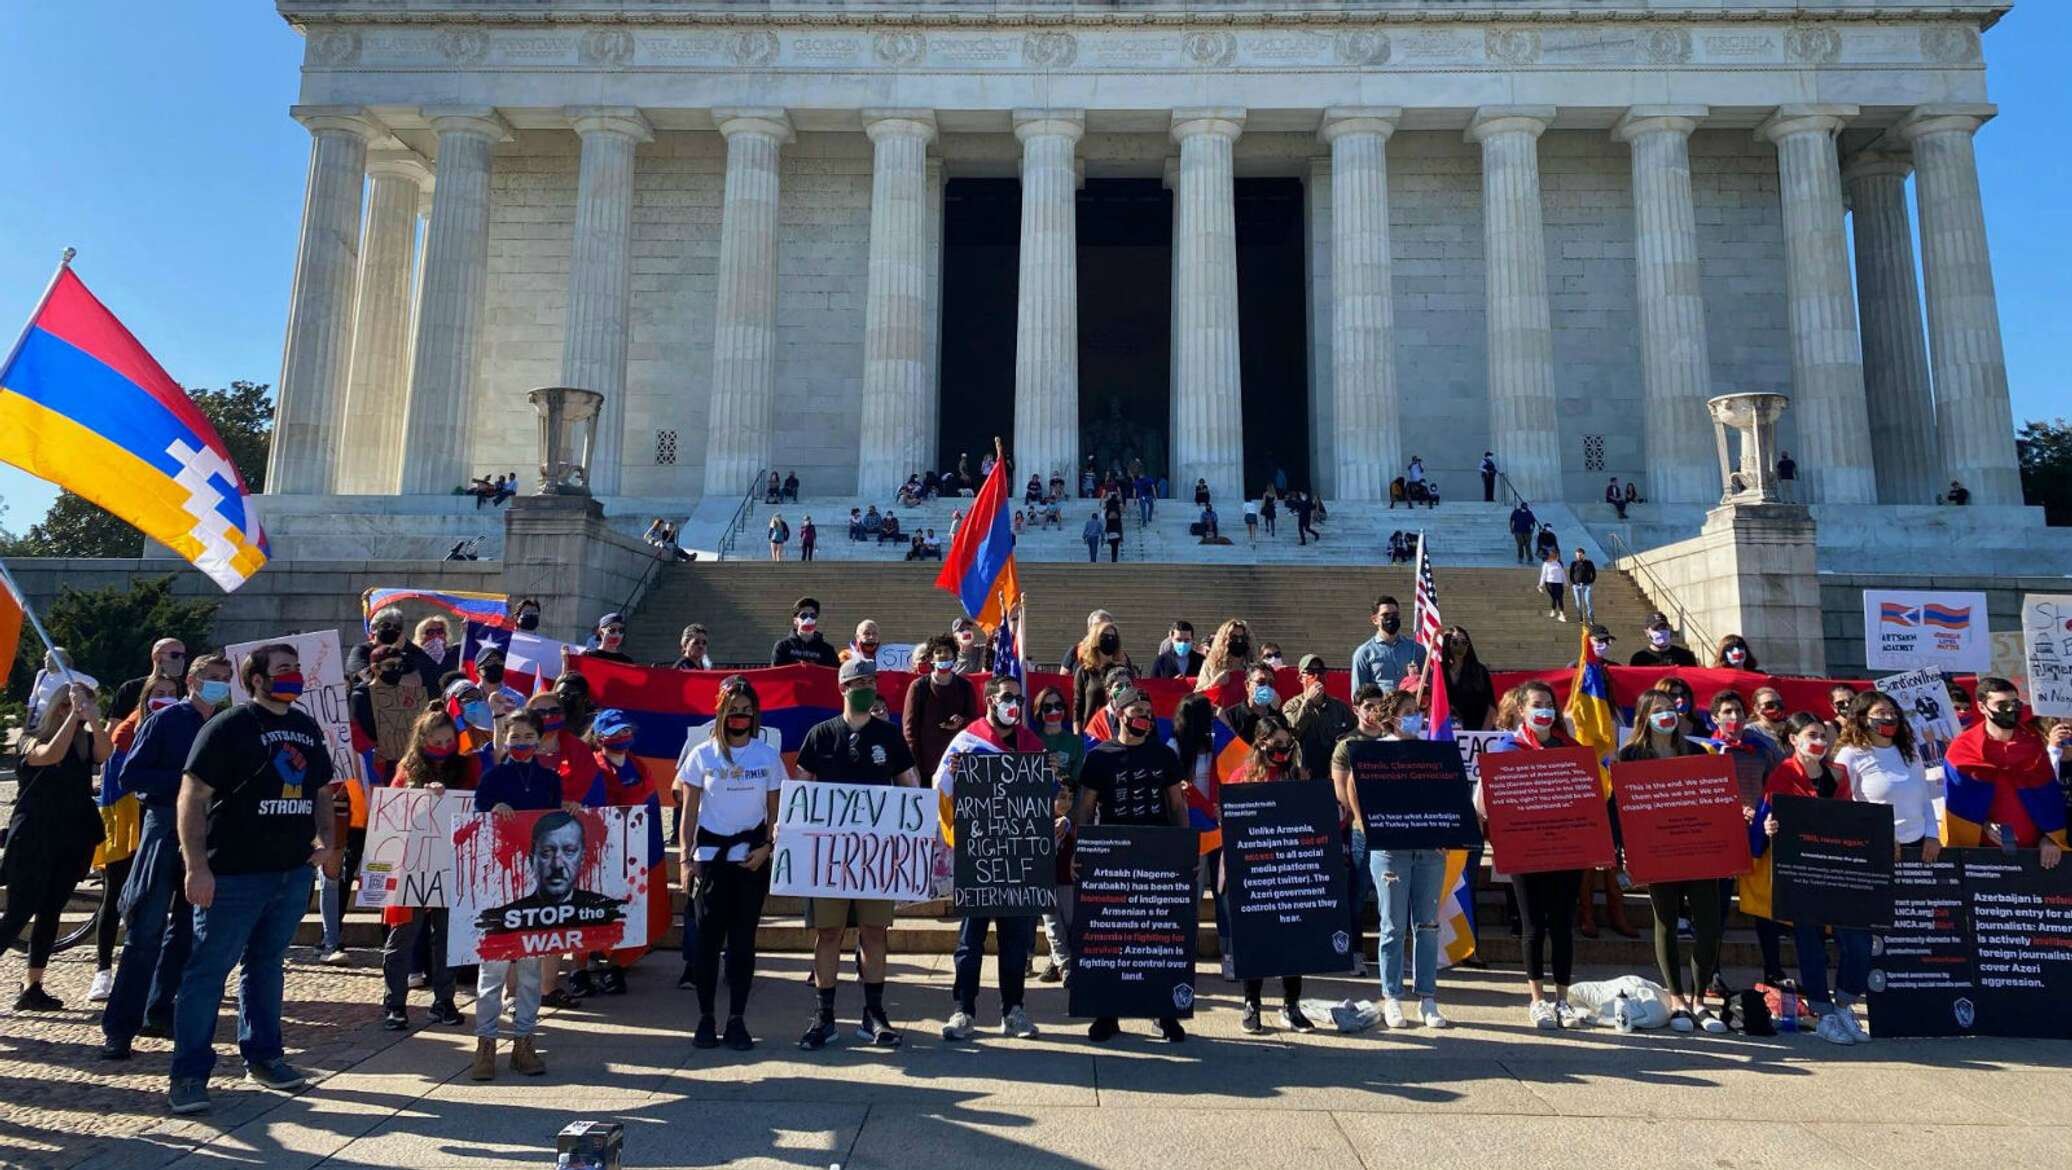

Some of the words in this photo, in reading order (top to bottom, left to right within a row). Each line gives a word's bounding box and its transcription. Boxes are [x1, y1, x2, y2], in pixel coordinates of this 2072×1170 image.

[260, 730, 314, 747] ARTSAKH
[955, 754, 1056, 783] ARTSAKH
[993, 783, 1007, 797] IS
[1667, 780, 1682, 788] end.
[258, 799, 313, 815] STRONG
[374, 790, 441, 834] KICK
[785, 785, 887, 828] ALIYEV
[899, 793, 924, 832] IS
[955, 796, 1051, 819] ARMENIAN
[1622, 803, 1652, 811] chasing
[970, 820, 983, 838] &
[988, 818, 1020, 835] HAS
[1024, 819, 1036, 835] A
[1248, 827, 1275, 835] Unlike
[1276, 824, 1314, 834] Armenia,
[967, 837, 1023, 857] RIGHT
[1025, 836, 1050, 856] TO
[1237, 839, 1283, 849] Azerbaijan
[1283, 838, 1299, 846] has
[374, 836, 441, 872] OUT
[1276, 851, 1285, 859] to
[1286, 850, 1297, 859] all
[1298, 849, 1323, 858] social
[774, 848, 792, 885] A
[803, 832, 937, 898] TERRORIST
[976, 858, 1034, 883] SELF
[1251, 865, 1276, 873] media
[1278, 862, 1319, 873] platforms
[1093, 868, 1131, 877] Artsakh
[1133, 868, 1180, 880] (Nagorno-
[403, 866, 450, 909] NA
[1082, 881, 1130, 891] Karabakh)
[1131, 882, 1149, 890] has
[1150, 882, 1173, 890] been
[1175, 882, 1190, 890] the
[1243, 878, 1276, 889] (except
[1277, 875, 1312, 885] twitter).
[1313, 874, 1330, 882] The
[955, 887, 1057, 907] DETERMINATION
[1250, 890, 1273, 899] Azeri
[1274, 887, 1326, 898] government
[1974, 893, 2031, 904] Azerbaijan
[2033, 894, 2042, 904] is
[1128, 895, 1138, 903] of
[1139, 895, 1190, 905] indigenous
[1241, 903, 1276, 912] controls
[1277, 902, 1292, 910] the
[1293, 901, 1317, 909] news
[1318, 899, 1337, 909] they
[504, 905, 575, 929] STOP
[578, 907, 605, 920] the
[1102, 907, 1146, 916] Armenian
[1155, 907, 1168, 916] for
[1974, 906, 2013, 918] foreign
[2015, 908, 2044, 919] entry
[2046, 908, 2062, 918] for
[1279, 914, 1301, 922] hear.
[1090, 920, 1139, 929] thousands
[1140, 920, 1150, 929] of
[1152, 922, 1180, 931] years.
[1976, 920, 2036, 932] journalists:
[522, 930, 584, 953] WAR
[1977, 934, 1987, 944] is
[1989, 934, 2031, 946] actively
[1124, 946, 1174, 956] Azerbaijan
[1175, 947, 1184, 955] is
[1979, 948, 2017, 960] foreign
[1079, 959, 1116, 969] fighting
[1117, 959, 1131, 967] for
[1132, 959, 1165, 968] control
[1980, 964, 2010, 972] cover
[2012, 963, 2041, 973] Azeri
[1121, 972, 1144, 980] land.
[1981, 978, 2045, 988] aggression.
